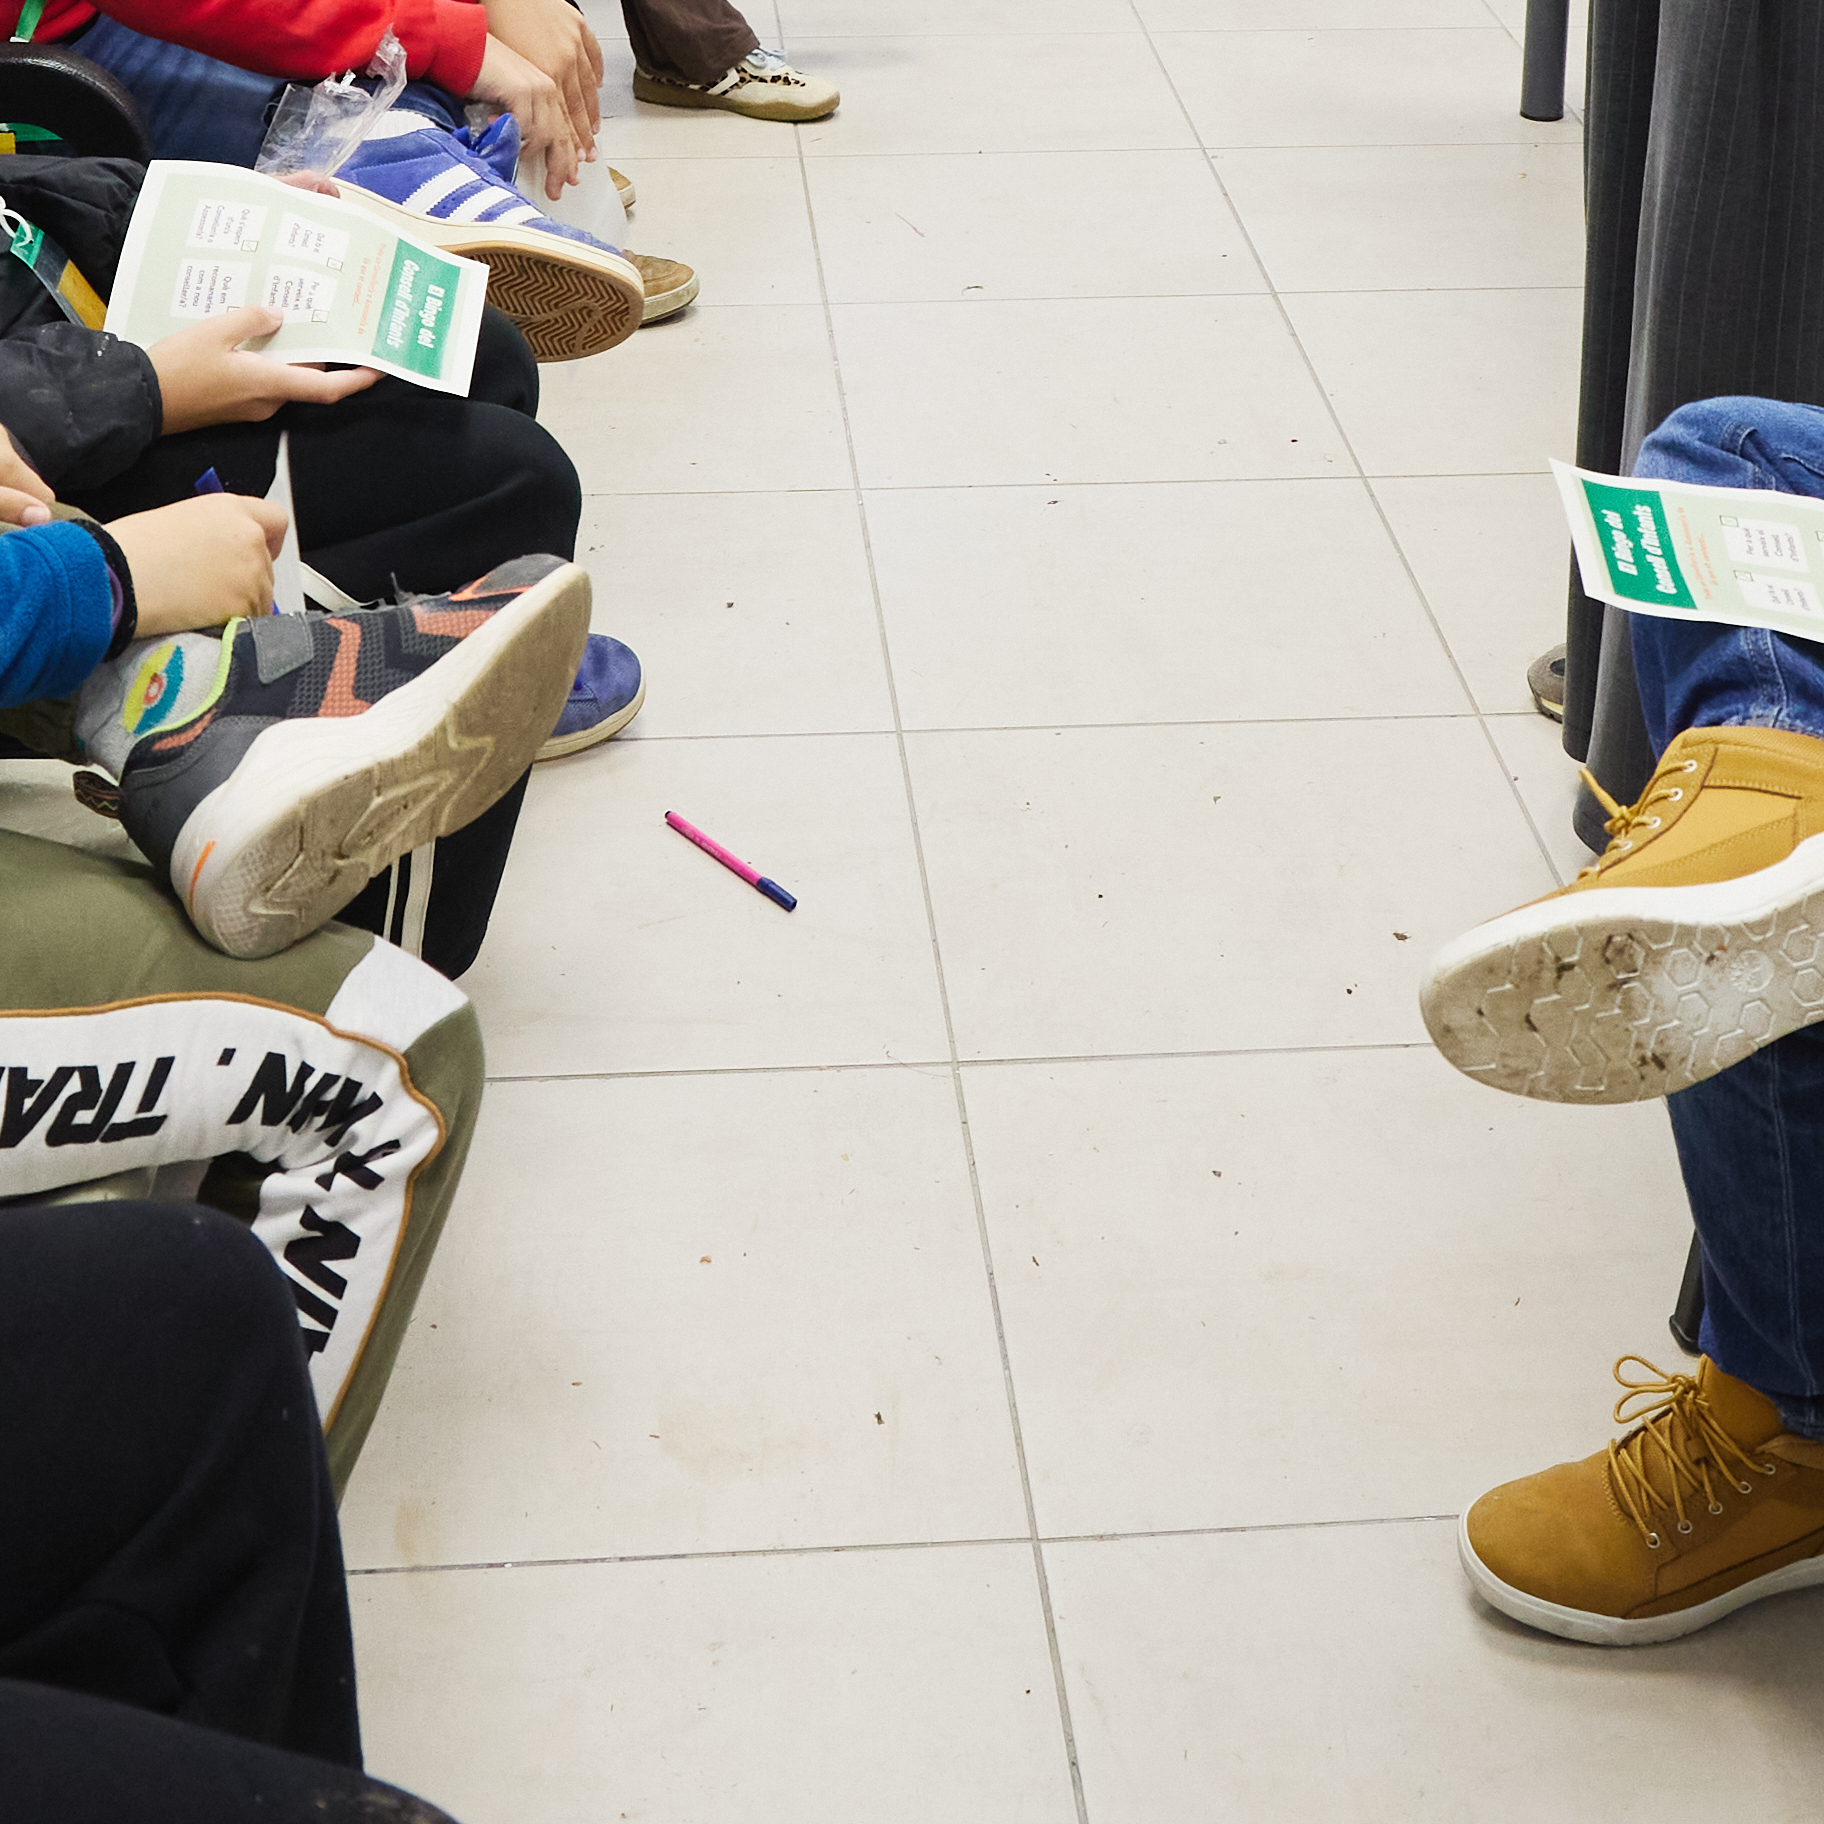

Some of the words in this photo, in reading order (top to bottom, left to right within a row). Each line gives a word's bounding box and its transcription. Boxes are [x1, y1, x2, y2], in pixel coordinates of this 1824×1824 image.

[396, 259, 420, 302] Consell
[428, 284, 445, 298] El
[386, 299, 410, 348] d'Infants
[418, 296, 443, 328] Bingo
[417, 328, 436, 348] del
